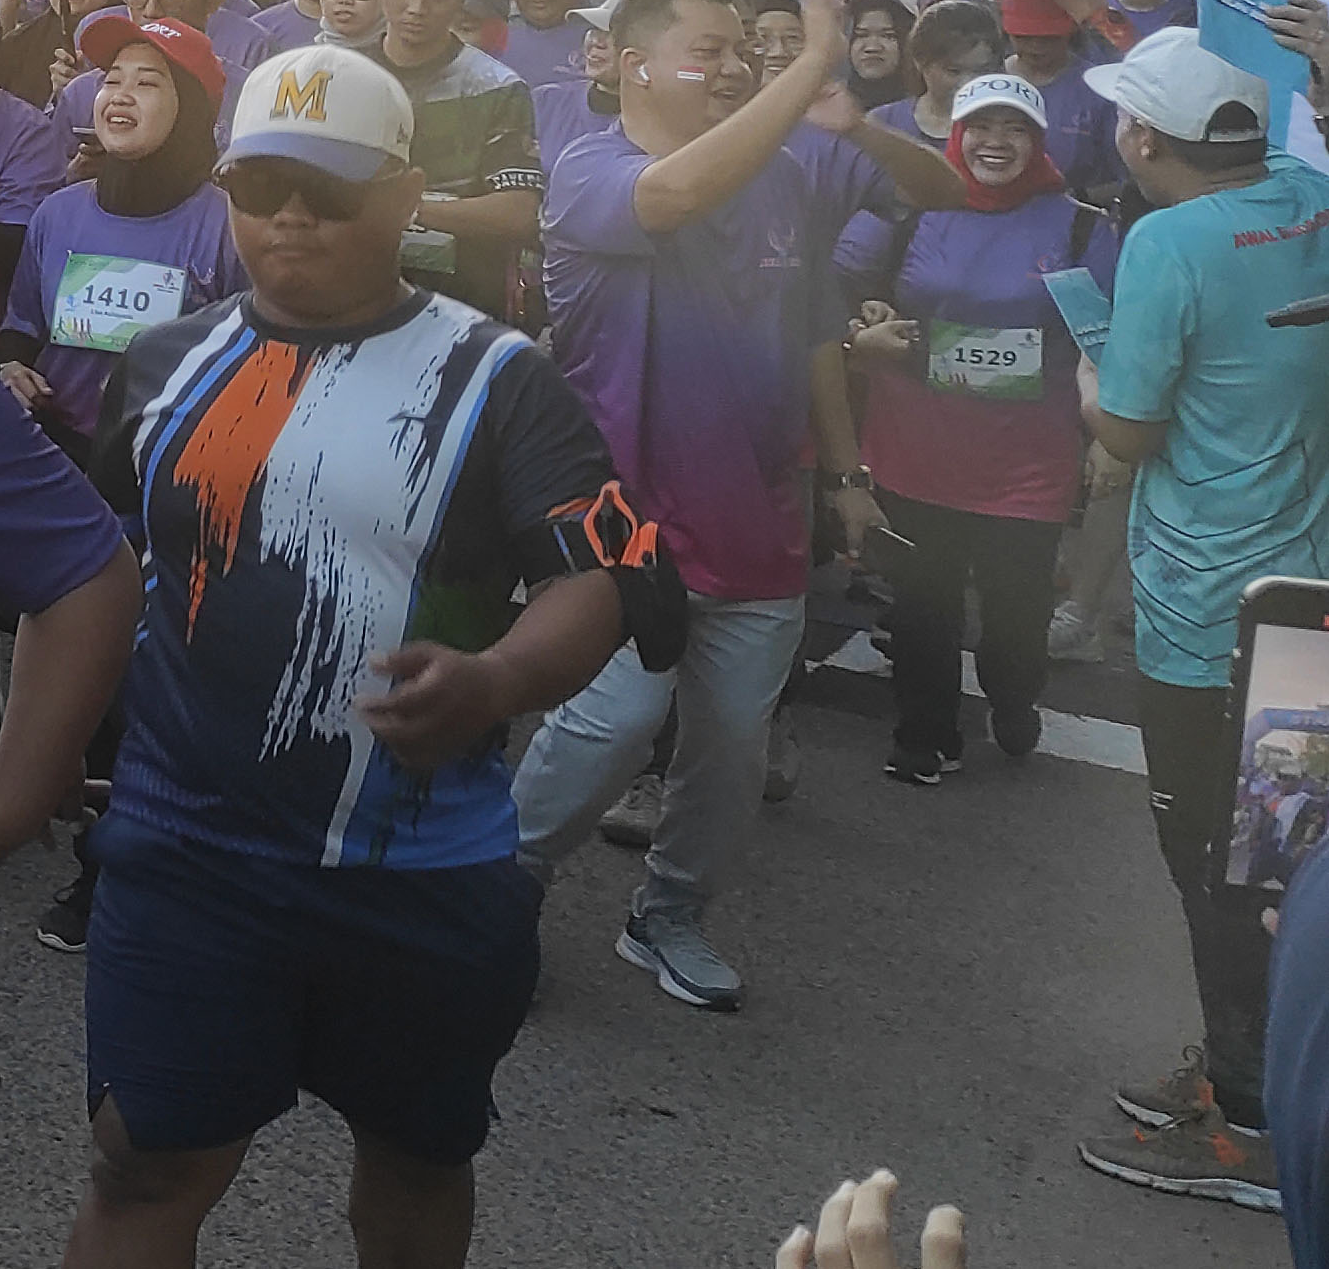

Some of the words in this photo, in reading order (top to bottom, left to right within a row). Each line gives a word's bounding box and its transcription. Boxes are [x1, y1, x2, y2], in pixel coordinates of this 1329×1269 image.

[269, 69, 334, 121] M
[957, 79, 1040, 108] SPORT
[1233, 228, 1280, 249] AWAL
[82, 284, 151, 312] 1410
[954, 346, 1017, 367] 1529
